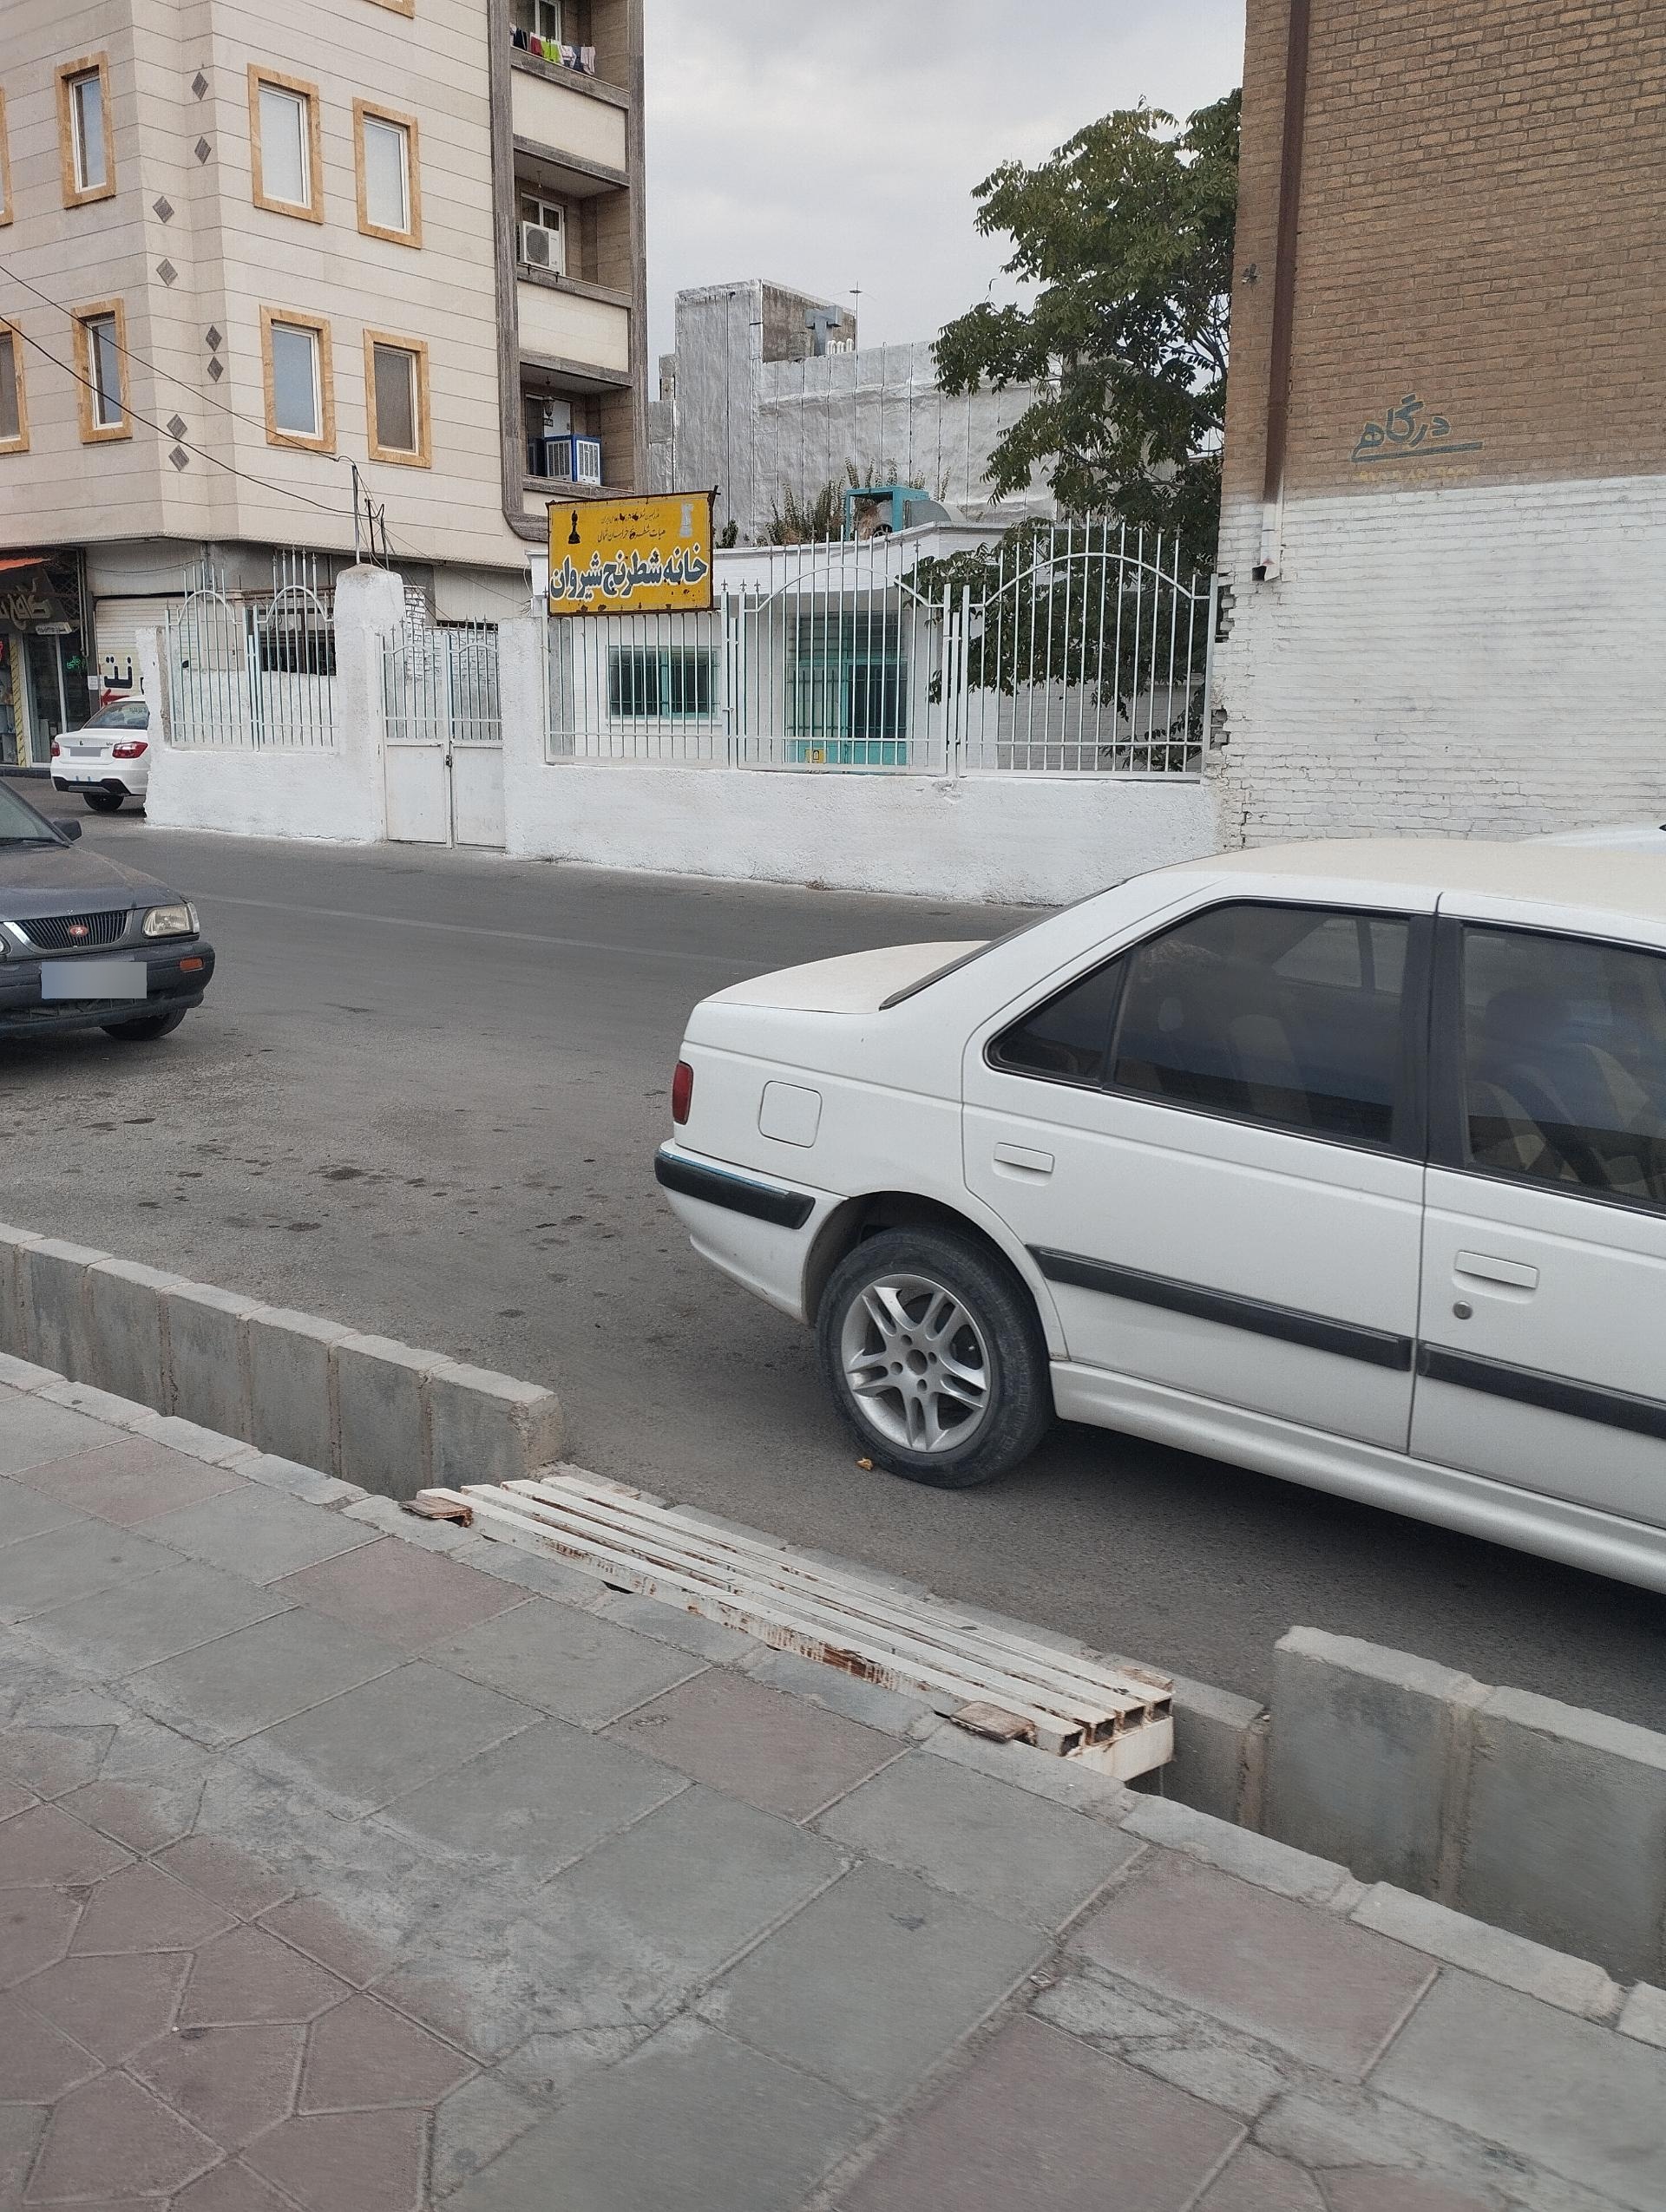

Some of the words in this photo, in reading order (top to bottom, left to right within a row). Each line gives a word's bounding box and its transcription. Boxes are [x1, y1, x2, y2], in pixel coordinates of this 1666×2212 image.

[550, 549, 604, 602] شیروان
[602, 546, 663, 598] شطرنج
[663, 542, 708, 586] خانه
